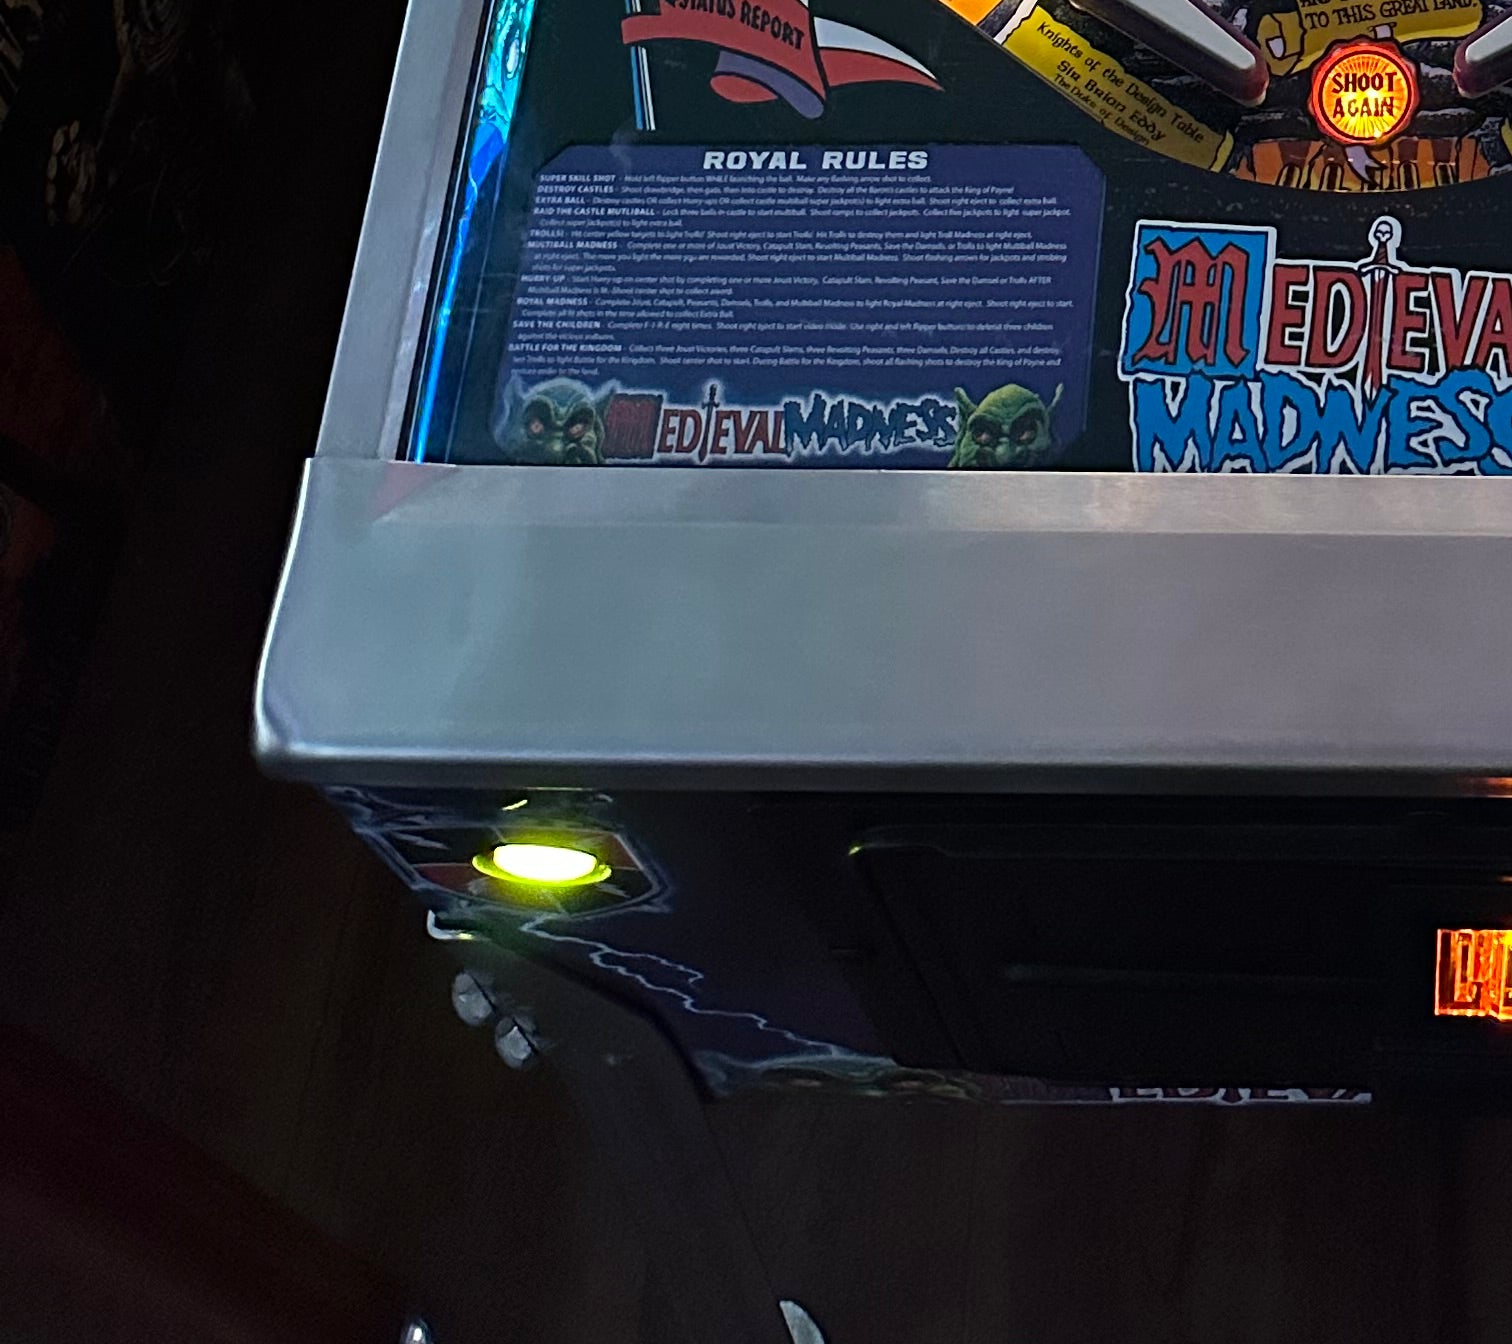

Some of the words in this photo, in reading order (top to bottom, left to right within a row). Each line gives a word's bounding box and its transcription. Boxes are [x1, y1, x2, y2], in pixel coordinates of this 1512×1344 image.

[1305, 11, 1330, 30] TO
[1332, 4, 1377, 25] THIS
[740, 0, 806, 50] REPORT
[1037, 21, 1083, 59] Knights
[1084, 55, 1102, 73] of
[1102, 67, 1124, 88] the
[1127, 82, 1166, 118] Design
[1170, 113, 1204, 144] Table
[1057, 60, 1082, 82] Sir
[1084, 78, 1127, 113] Brian
[1332, 71, 1398, 94] SHOOT
[1332, 97, 1394, 118] AGAIN
[703, 150, 808, 170] ROYAL
[821, 150, 929, 170] RULES
[540, 174, 567, 182] SUPER
[568, 174, 591, 182] SKILL
[593, 174, 616, 182] SHOT
[537, 185, 576, 193] DESTROY
[577, 185, 614, 193] CASTLES
[535, 196, 563, 204] EXTRA
[564, 196, 585, 204] BALL
[574, 208, 605, 216] CASTLE
[576, 241, 617, 249] MADNESS
[516, 297, 543, 305] ROYAL
[546, 297, 588, 305] MADNESS
[513, 321, 534, 329] SAVE
[556, 321, 600, 329] CHILDREN
[508, 344, 540, 352] BATTLE
[542, 344, 559, 352] FOR
[561, 344, 577, 352] THE
[579, 344, 622, 352] KINGDOM
[604, 384, 787, 462] EDIEVAL
[784, 391, 958, 458] MADNESS
